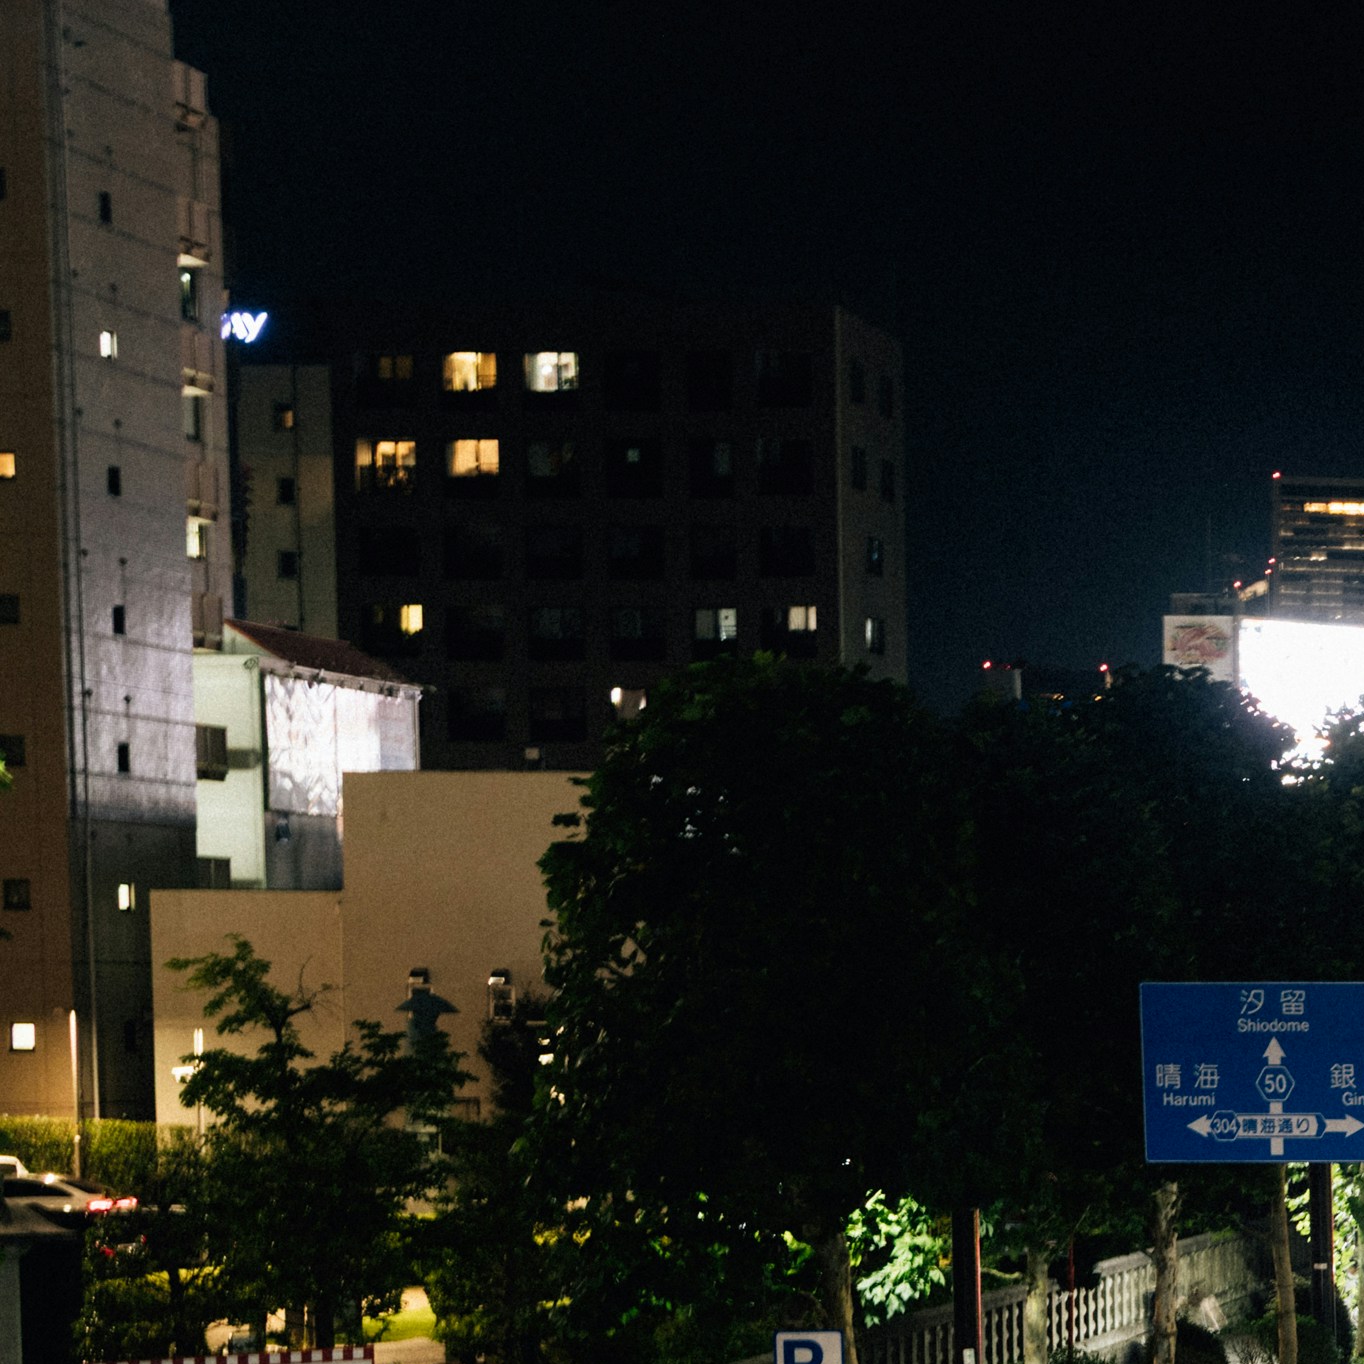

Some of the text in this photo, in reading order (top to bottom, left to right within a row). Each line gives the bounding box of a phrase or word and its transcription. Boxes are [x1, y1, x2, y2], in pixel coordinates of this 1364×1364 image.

[1239, 989, 1306, 1015] 汐留
[1237, 1018, 1310, 1033] Shiodome
[1155, 1062, 1220, 1089] 晴海
[1264, 1074, 1287, 1093] 50
[1162, 1092, 1216, 1106] Harumi
[1212, 1118, 1237, 1134] 304
[1241, 1117, 1310, 1134] 晴海通り
